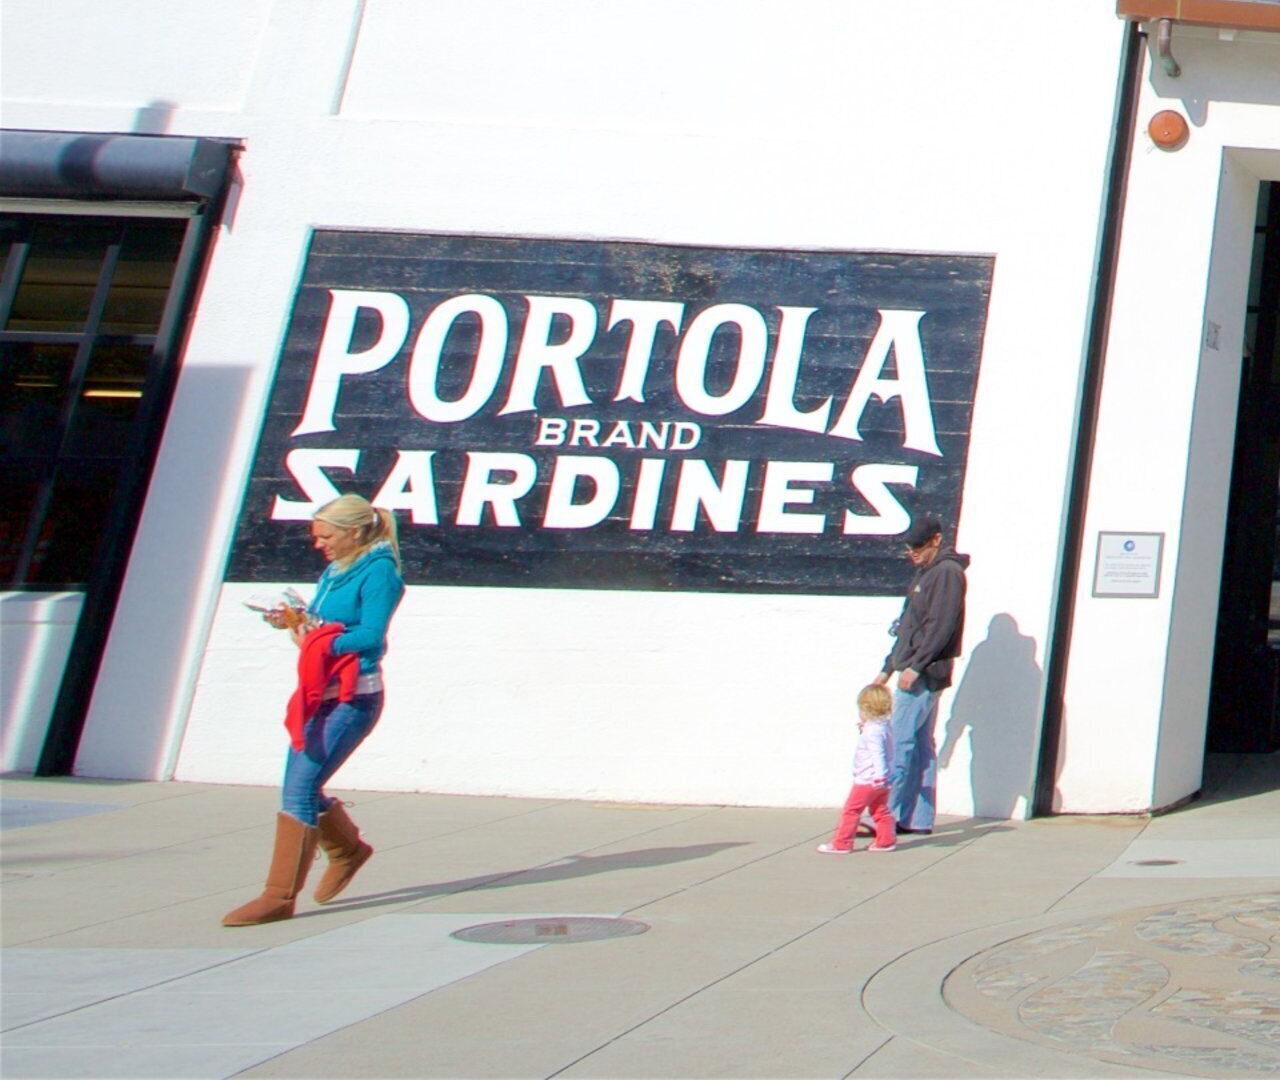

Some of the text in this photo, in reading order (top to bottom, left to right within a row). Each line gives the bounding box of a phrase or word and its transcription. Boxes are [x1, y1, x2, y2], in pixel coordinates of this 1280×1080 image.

[291, 289, 944, 458] PORTOLA
[534, 418, 702, 452] BRAND
[269, 447, 919, 537] SARDINES
